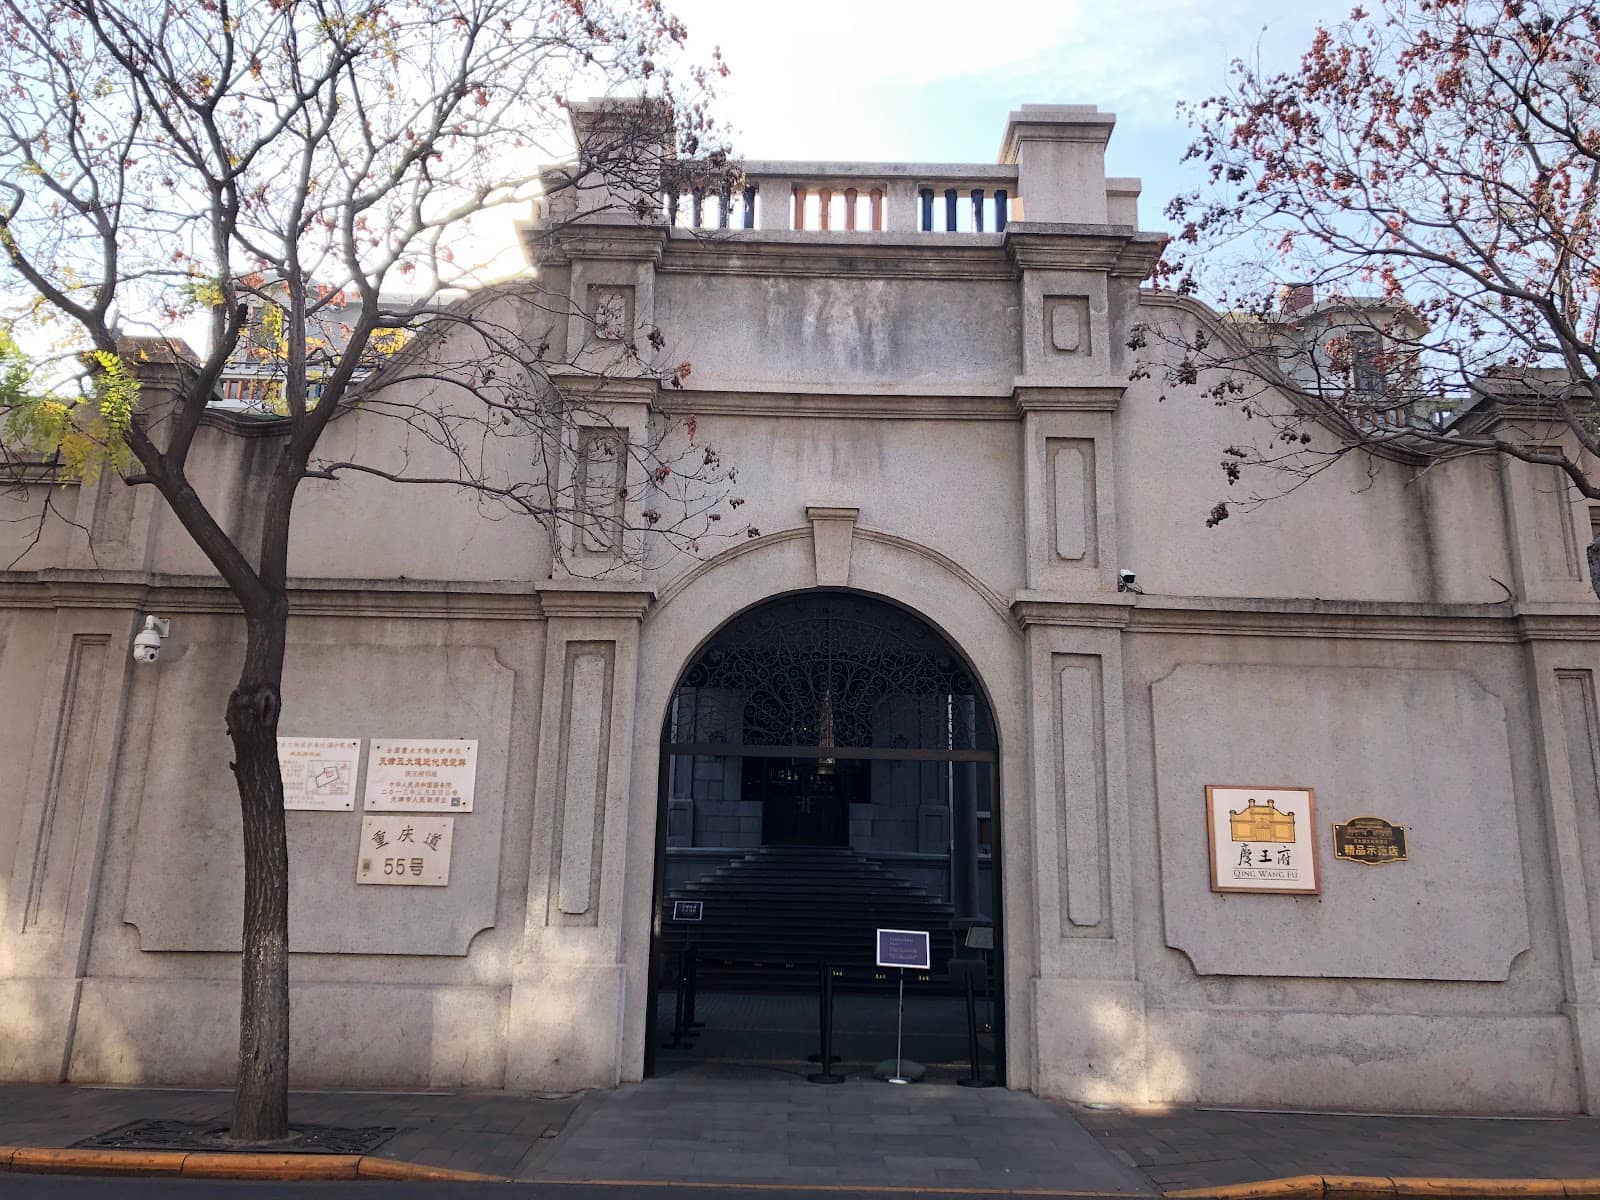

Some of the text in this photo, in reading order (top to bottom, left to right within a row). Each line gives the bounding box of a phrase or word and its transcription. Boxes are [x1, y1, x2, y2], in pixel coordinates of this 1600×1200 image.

[371, 824, 442, 852] 重庆道
[383, 857, 425, 876] 55号
[1233, 869, 1298, 879] QING WANG FU
